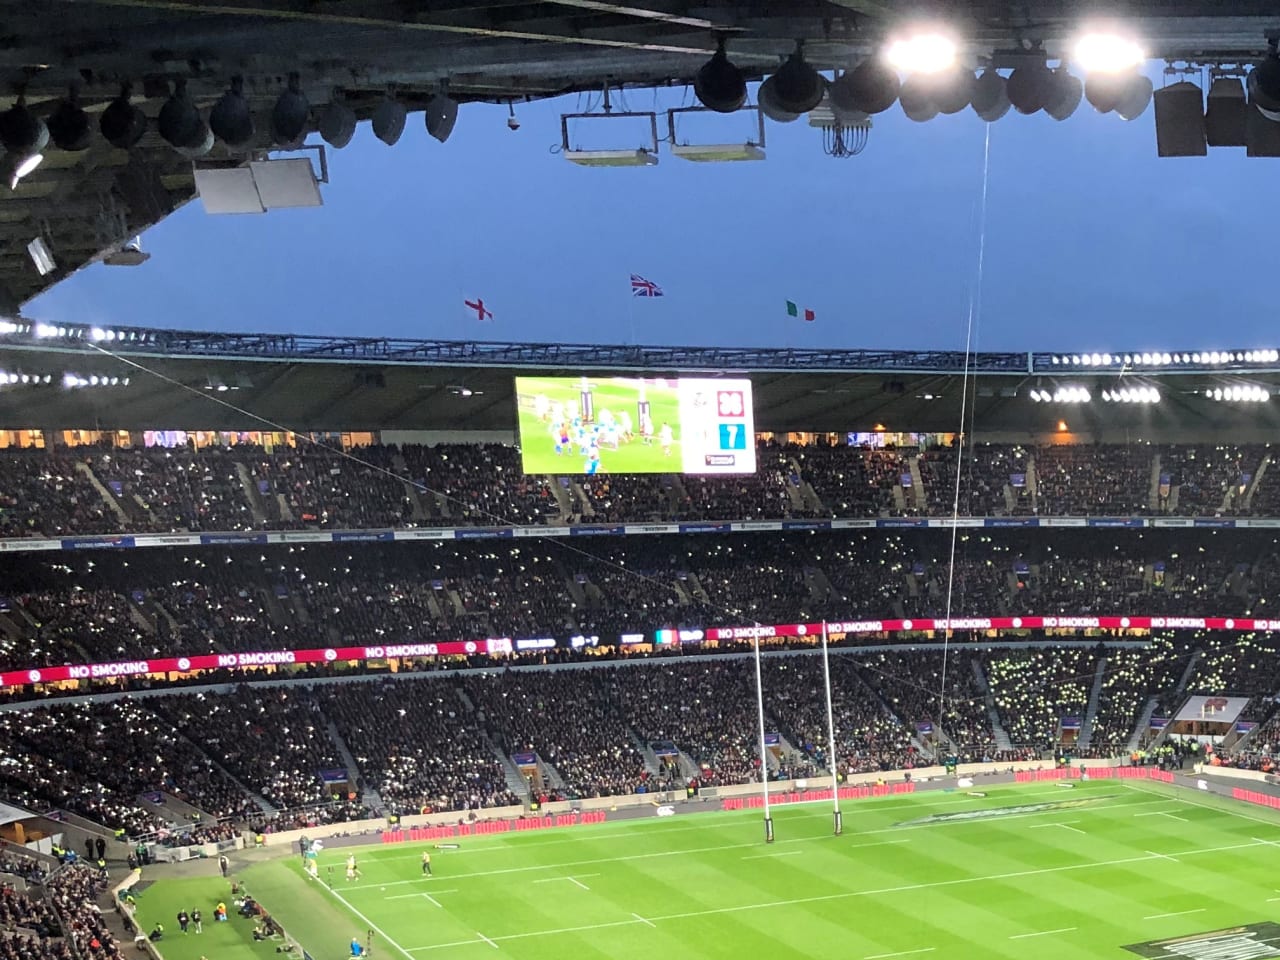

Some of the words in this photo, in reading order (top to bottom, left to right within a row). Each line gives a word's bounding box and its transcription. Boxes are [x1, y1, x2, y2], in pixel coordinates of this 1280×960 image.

[934, 619, 948, 628] NO
[1043, 617, 1056, 627] NO
[1151, 618, 1164, 627] NO
[1254, 620, 1267, 630] NO
[828, 623, 841, 632] NO
[718, 629, 732, 638] NO
[365, 647, 384, 657] NO
[386, 645, 437, 656] SMOKING
[218, 655, 237, 666] NO
[239, 652, 295, 664] SMOKING
[69, 667, 89, 678] NO
[92, 661, 149, 676] SMOKING
